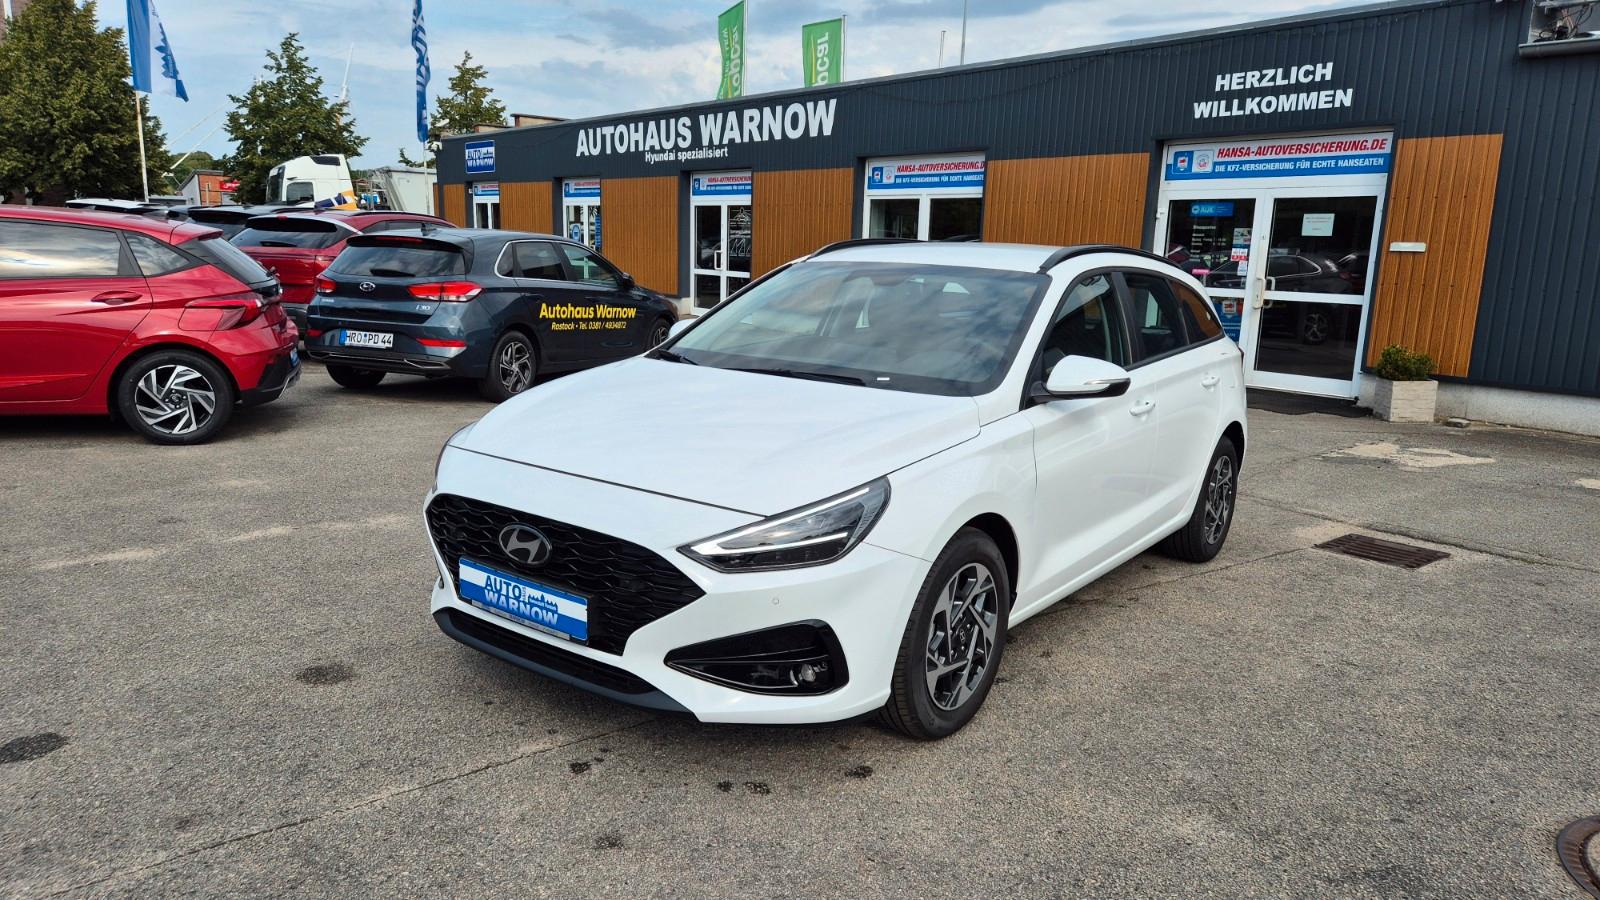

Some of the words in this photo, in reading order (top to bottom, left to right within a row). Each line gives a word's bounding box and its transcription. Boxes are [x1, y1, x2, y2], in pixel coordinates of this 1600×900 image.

[1214, 62, 1334, 92] HERZLICH
[1193, 88, 1354, 119] WILLKOMMEN
[576, 116, 692, 156] AUTOHAUS
[699, 99, 838, 146] WARNOW
[645, 150, 676, 165] Hyundai
[677, 146, 729, 163] spezialisiert
[1217, 139, 1388, 158] HANSA-AUTOVERSICHERUNG.DE
[1227, 162, 1294, 172] KFZ-VERSICHERUNG
[1296, 160, 1310, 170] FÜR
[1312, 160, 1336, 170] ECHTE
[1337, 157, 1384, 168] HANSEATEN
[539, 303, 595, 318] Autohaus
[596, 304, 637, 318] Warnow
[551, 322, 575, 330] Rostock
[346, 331, 363, 344] HRO
[367, 333, 380, 345] PD
[381, 335, 392, 345] 44
[483, 574, 522, 600] AUTO
[484, 589, 558, 626] WARNOW
